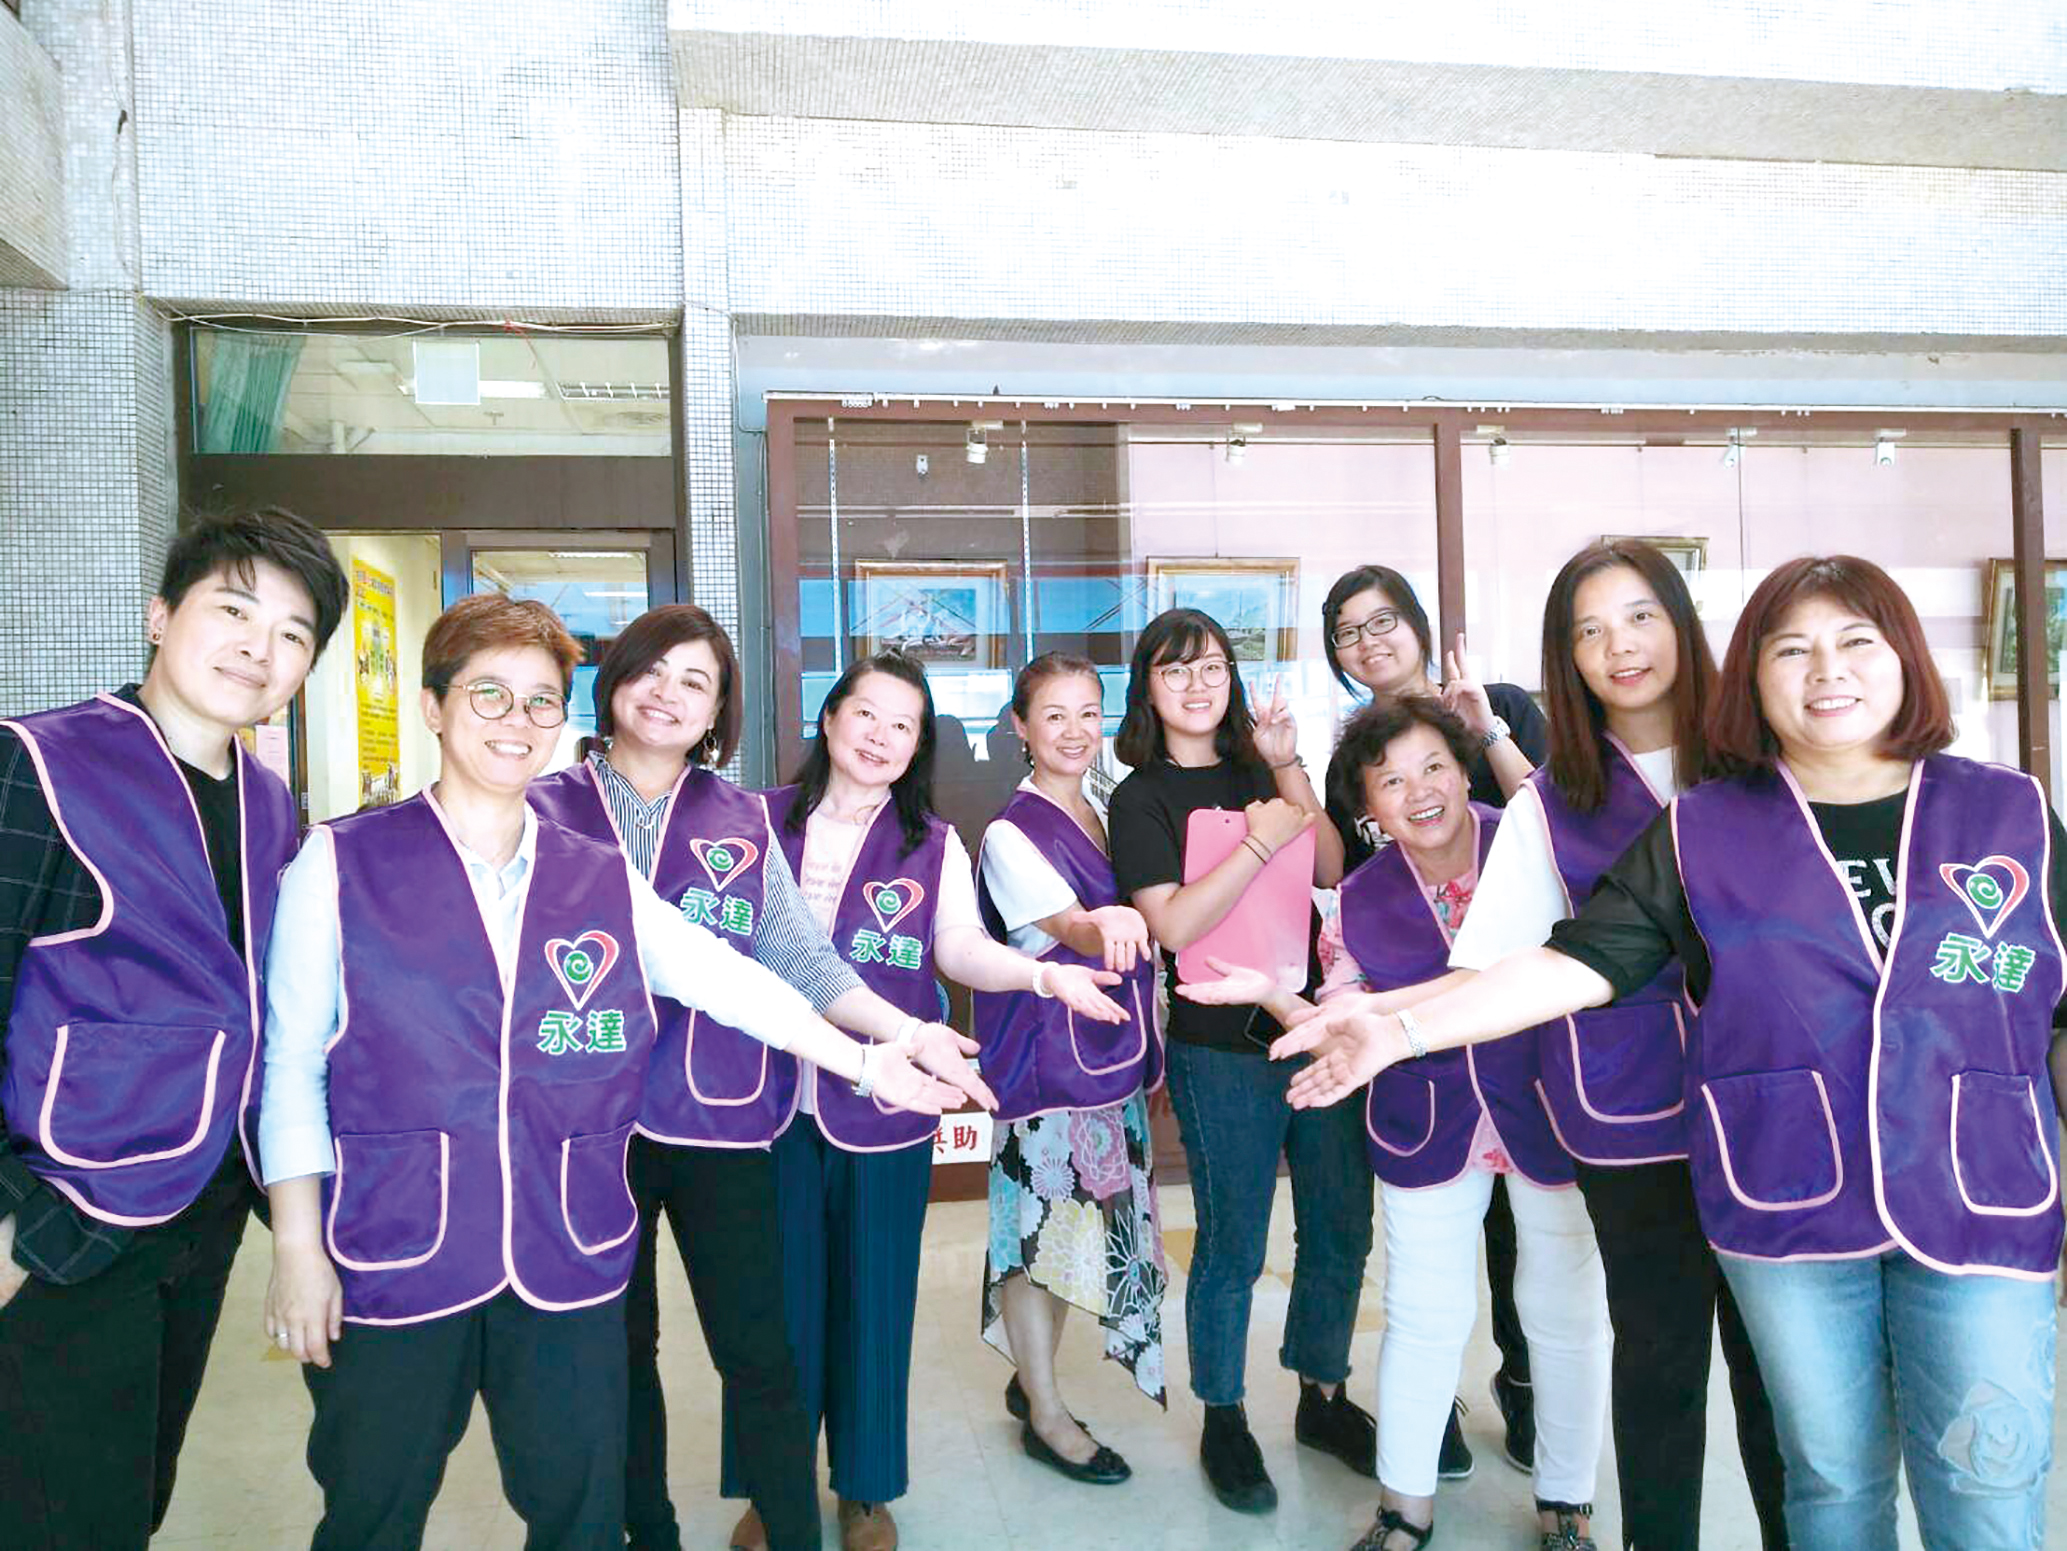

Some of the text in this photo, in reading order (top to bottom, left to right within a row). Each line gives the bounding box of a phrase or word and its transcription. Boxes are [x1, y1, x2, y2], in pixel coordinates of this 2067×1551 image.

[680, 887, 753, 936] 永達
[849, 928, 922, 970] 永達
[1930, 932, 2035, 993] 永達
[536, 1009, 627, 1055] 永達
